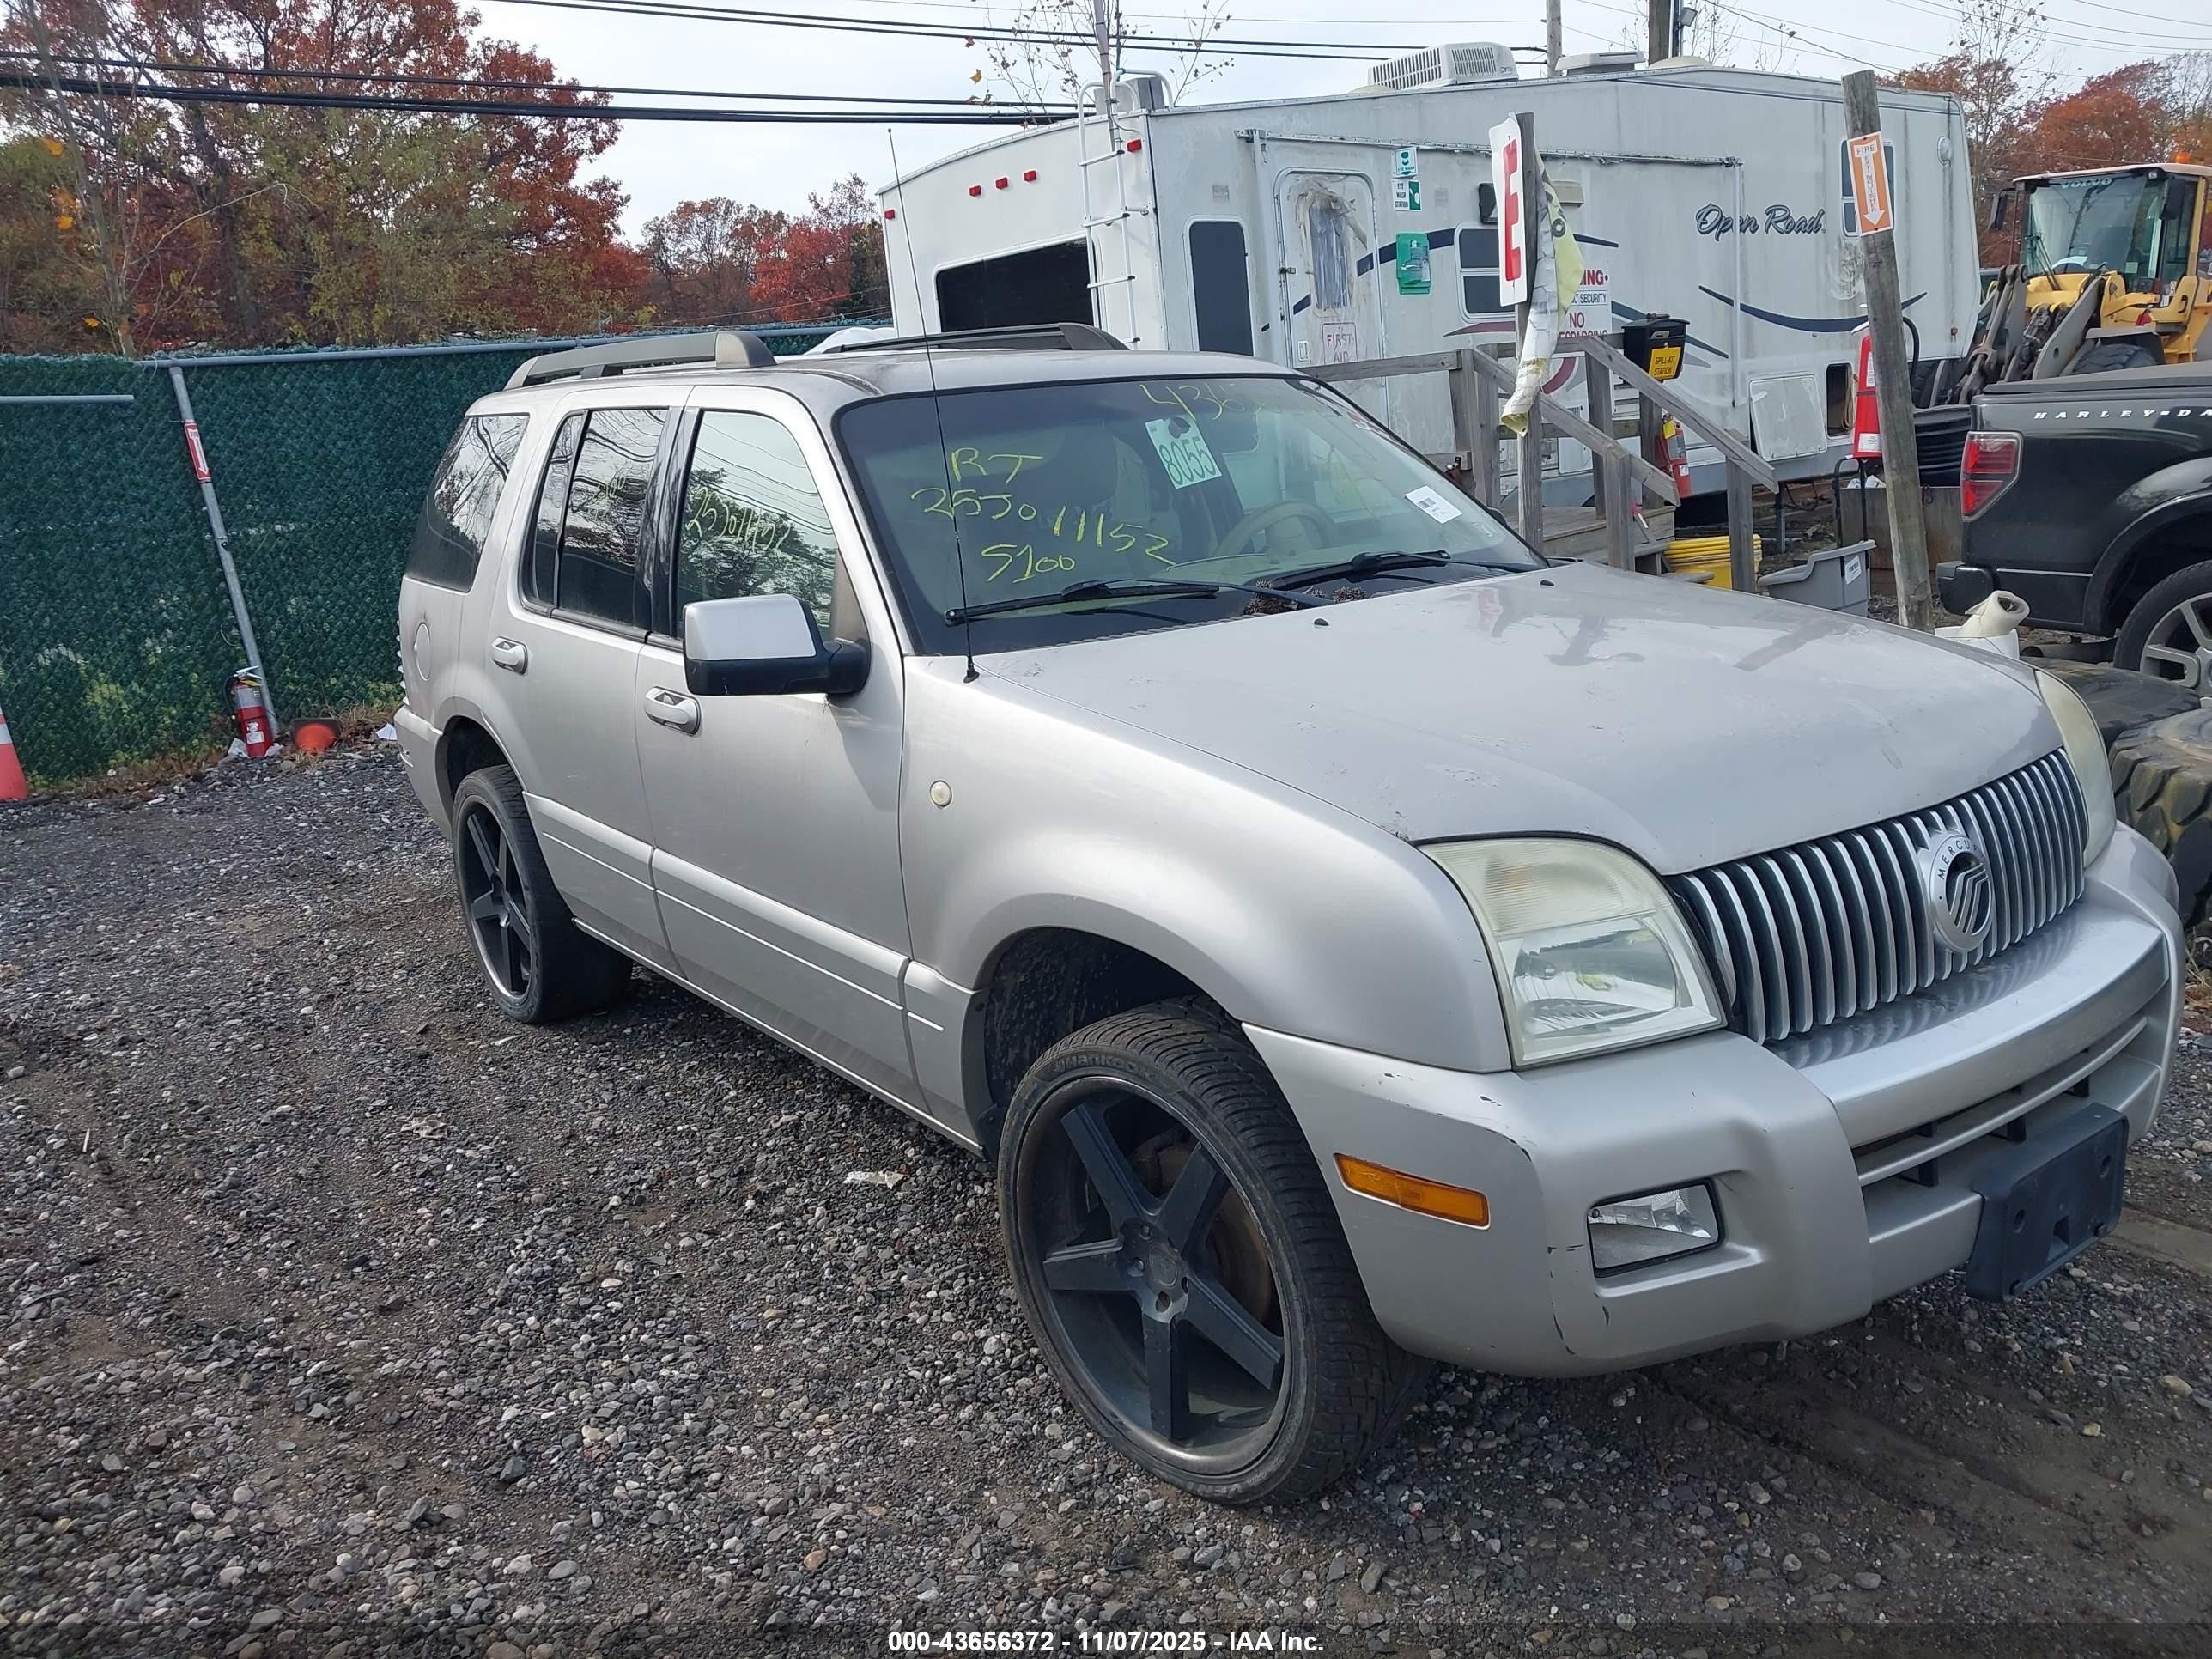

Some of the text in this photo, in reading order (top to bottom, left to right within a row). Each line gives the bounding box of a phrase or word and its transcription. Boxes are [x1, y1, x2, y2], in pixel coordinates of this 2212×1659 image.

[1856, 143, 1875, 156] FIRE
[2061, 178, 2112, 189] VOLVO
[1695, 203, 1826, 241] Opn Road
[1580, 293, 1607, 303] SECURITY
[1569, 312, 1585, 328] NO
[1327, 333, 1352, 346] FIRST
[1654, 367, 1672, 375] STATION
[951, 447, 1044, 484] RT
[1159, 436, 1217, 486] 8055
